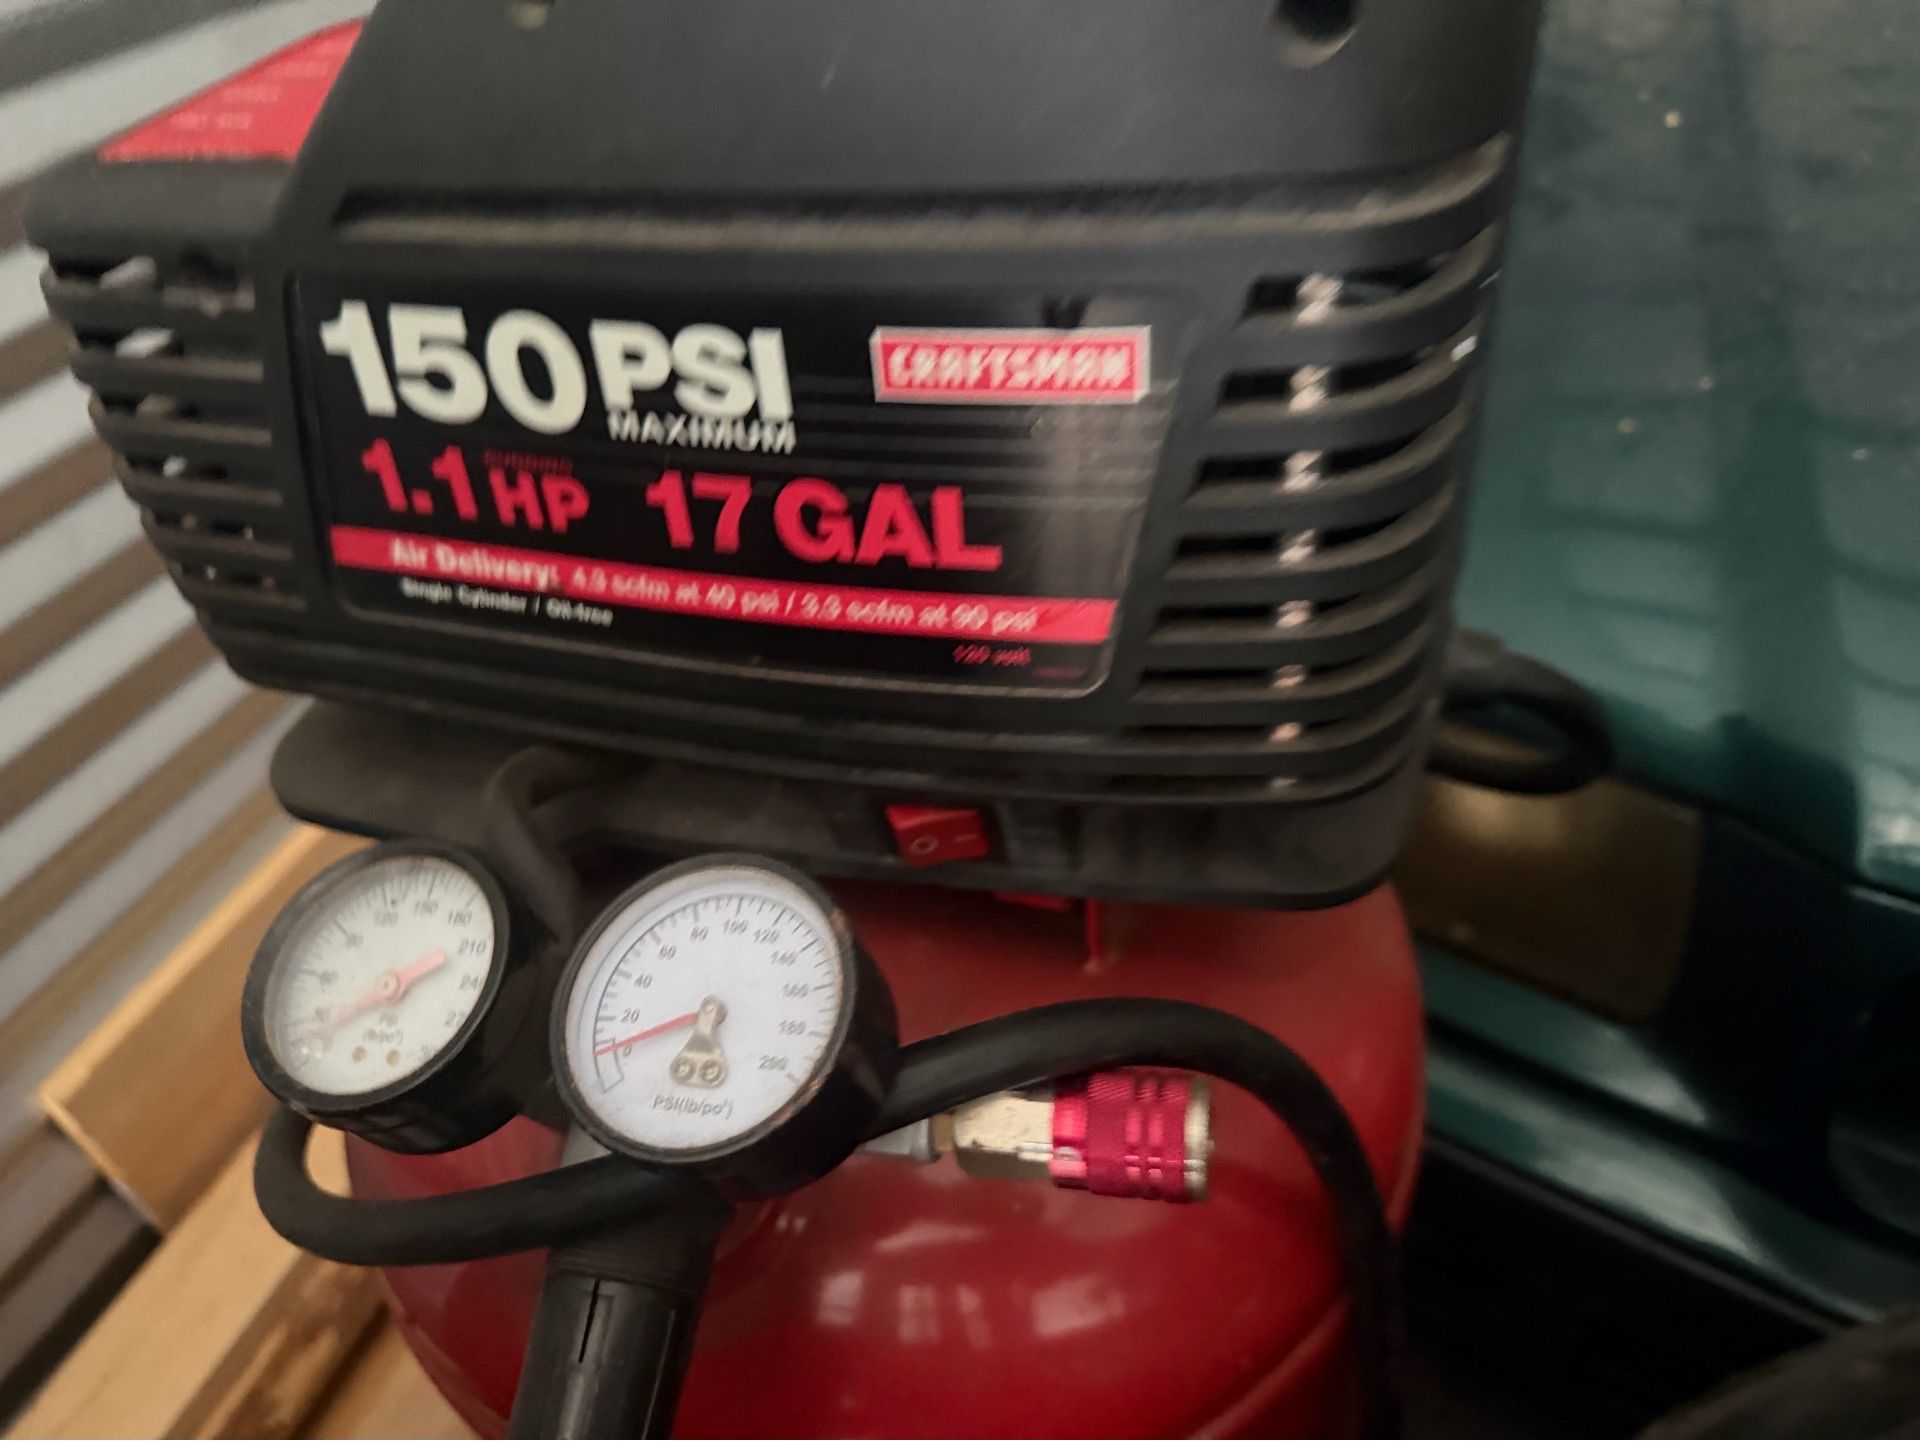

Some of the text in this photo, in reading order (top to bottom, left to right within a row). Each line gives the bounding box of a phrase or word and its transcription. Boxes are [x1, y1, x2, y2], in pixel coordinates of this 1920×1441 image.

[321, 299, 794, 435] 150 PSI
[887, 344, 1135, 390] CRAFTSMAN
[606, 410, 797, 455] MAXIMUM
[361, 436, 1003, 572] 1.1 HP 17 GAL
[391, 538, 428, 569] Air
[634, 974, 654, 988] 40
[620, 1008, 640, 1024] 20
